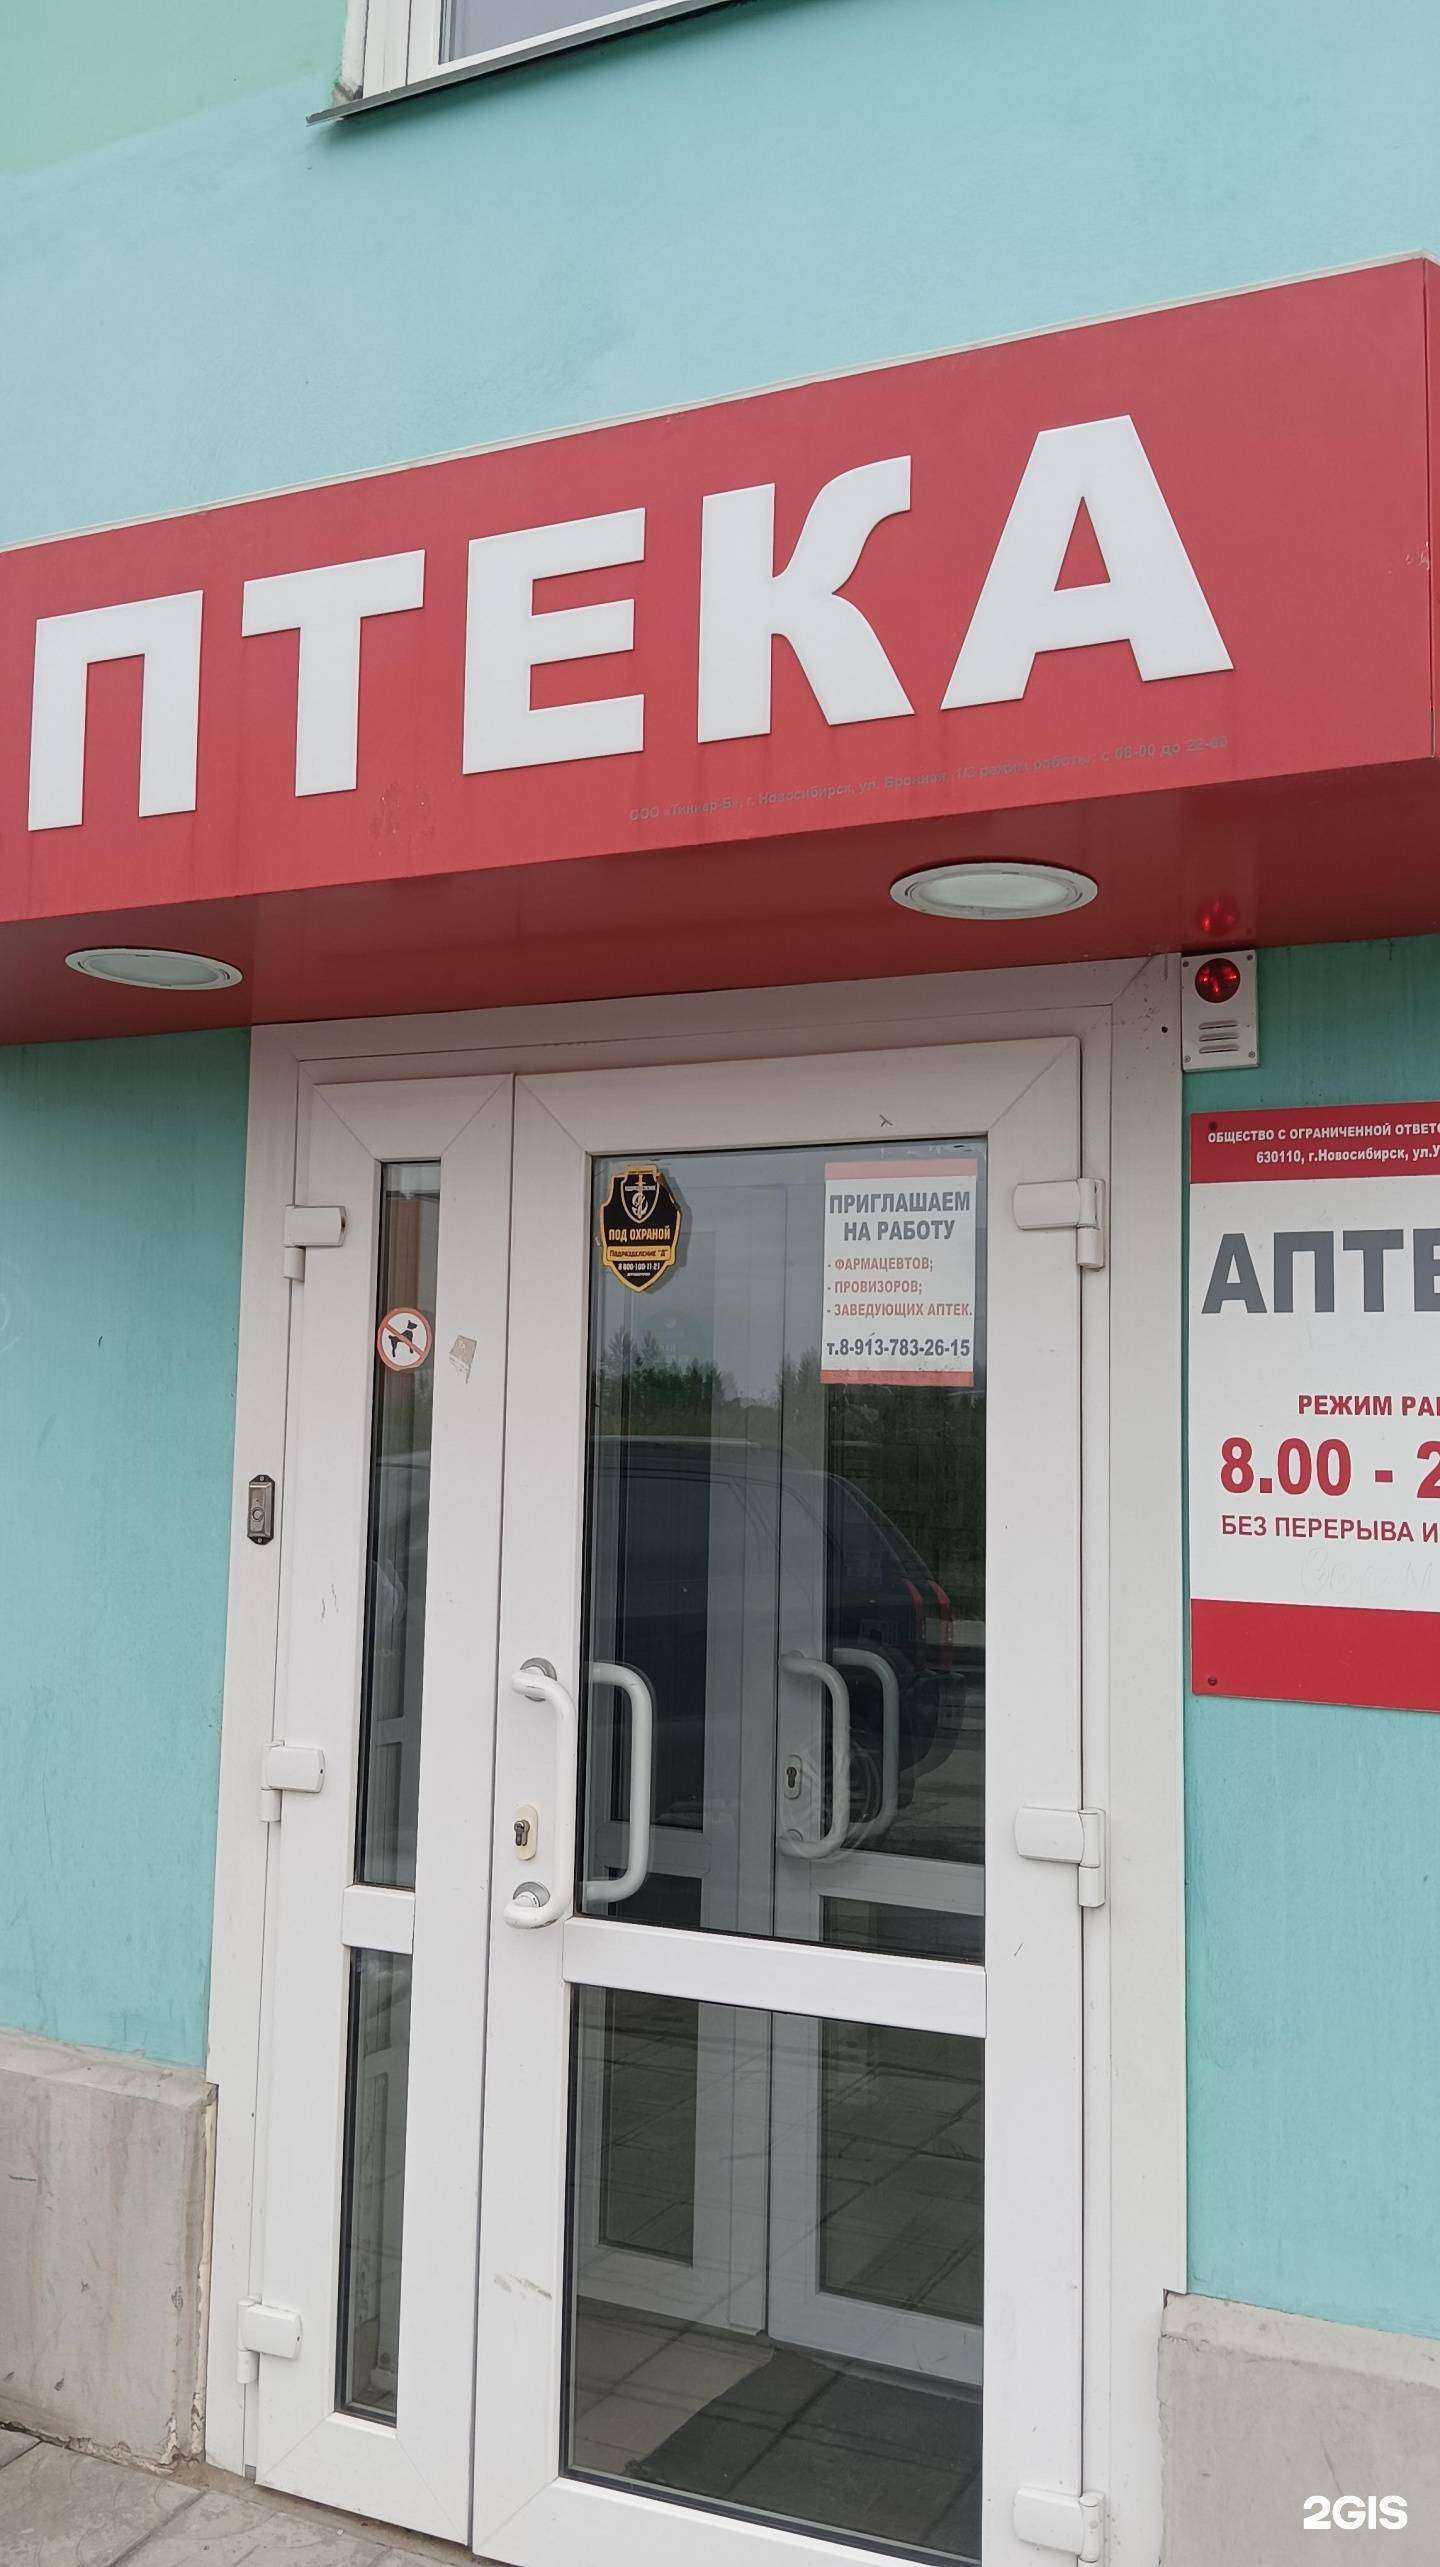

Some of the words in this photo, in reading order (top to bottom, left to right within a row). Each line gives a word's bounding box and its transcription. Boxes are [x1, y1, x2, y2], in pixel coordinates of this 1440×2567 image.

[28, 414, 1233, 832] ПТЕКА
[1207, 1128, 1275, 1144] ОБЩЕСТВО
[1277, 1128, 1286, 1140] С
[1289, 1122, 1392, 1140] ОГРАНИЧЕННОЙ
[1256, 1150, 1305, 1165] 630110,
[829, 1191, 971, 1214] ПРИГЛАШАЕМ
[608, 1228, 628, 1243] ПОД
[630, 1224, 671, 1241] ОХРАНОЙ
[843, 1220, 871, 1242] НА
[876, 1219, 956, 1242] РАБОТУ
[834, 1256, 934, 1272] ФАРМАЦЕВТОВ;
[834, 1280, 923, 1295] ПРОВИЗОРОВ;
[833, 1302, 924, 1319] ЗАВЕДУЮЩИХ
[926, 1302, 973, 1317] АПТЕК.
[826, 1337, 972, 1357] т.8-913-783-26-15
[1298, 1394, 1393, 1416] РЕЖИМ
[1401, 1395, 1440, 1417] РА
[1220, 1436, 1352, 1497] 8.00
[1221, 1514, 1267, 1537] БЕЗ
[1275, 1516, 1414, 1542] ПЕРЕРЫВА
[1422, 1522, 1438, 1544] И
